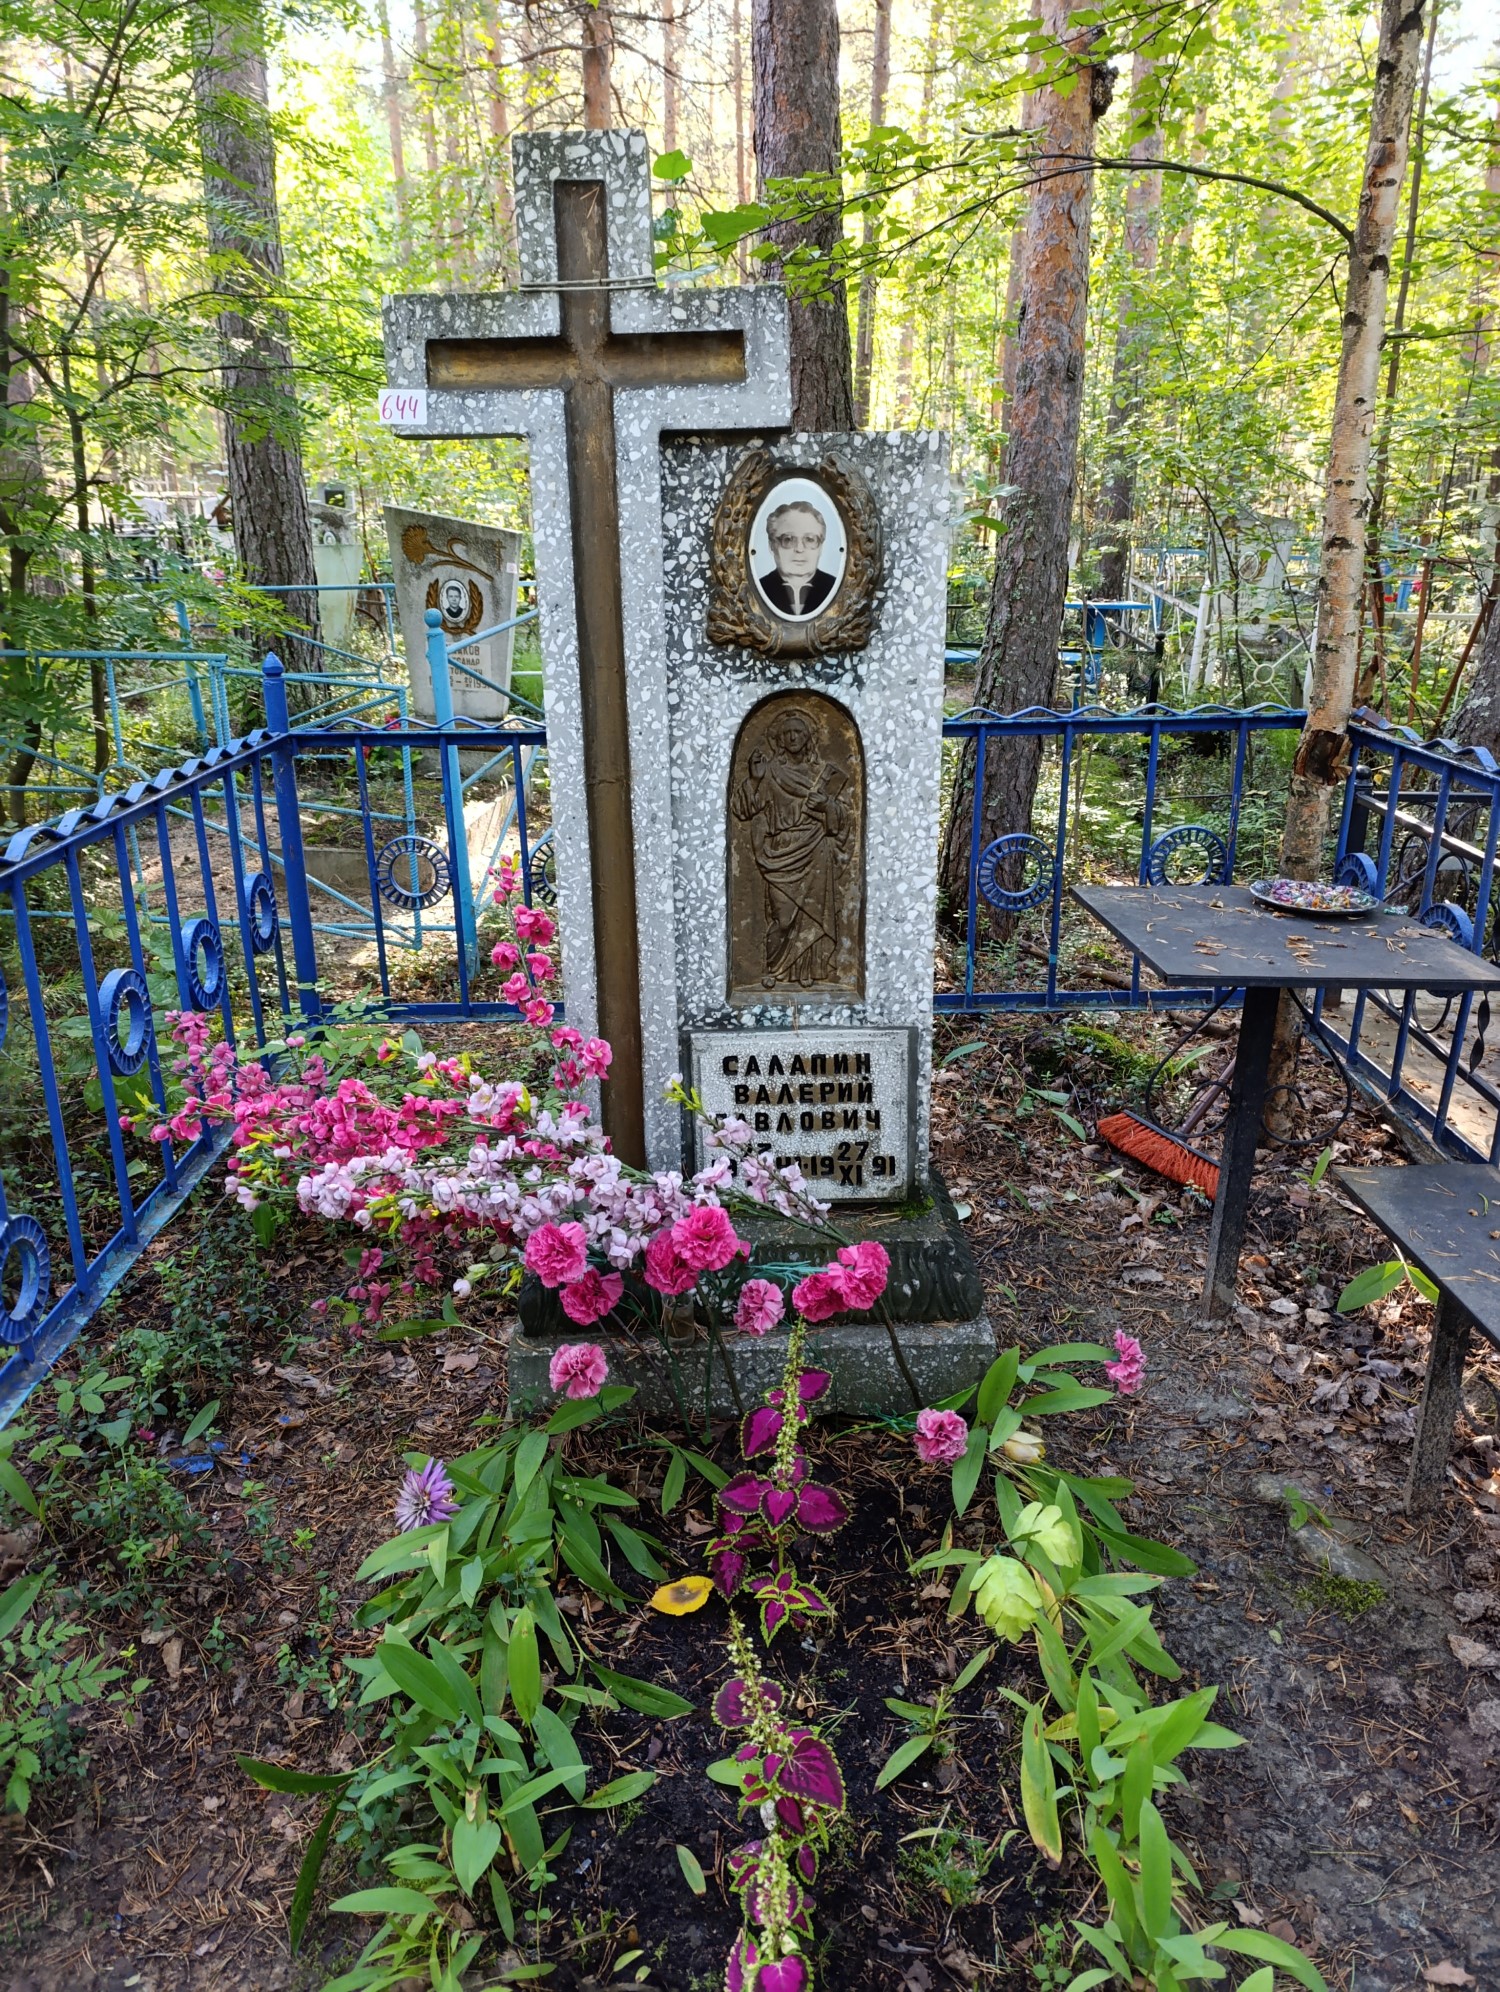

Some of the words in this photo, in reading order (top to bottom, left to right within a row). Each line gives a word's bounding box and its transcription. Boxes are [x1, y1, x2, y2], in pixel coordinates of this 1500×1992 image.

[381, 394, 419, 420] 644
[722, 1053, 871, 1076] САЛАПИН
[734, 1076, 873, 1105] ВАЛЕРИЙ
[838, 1141, 870, 1161] 27
[872, 1156, 896, 1176] 91
